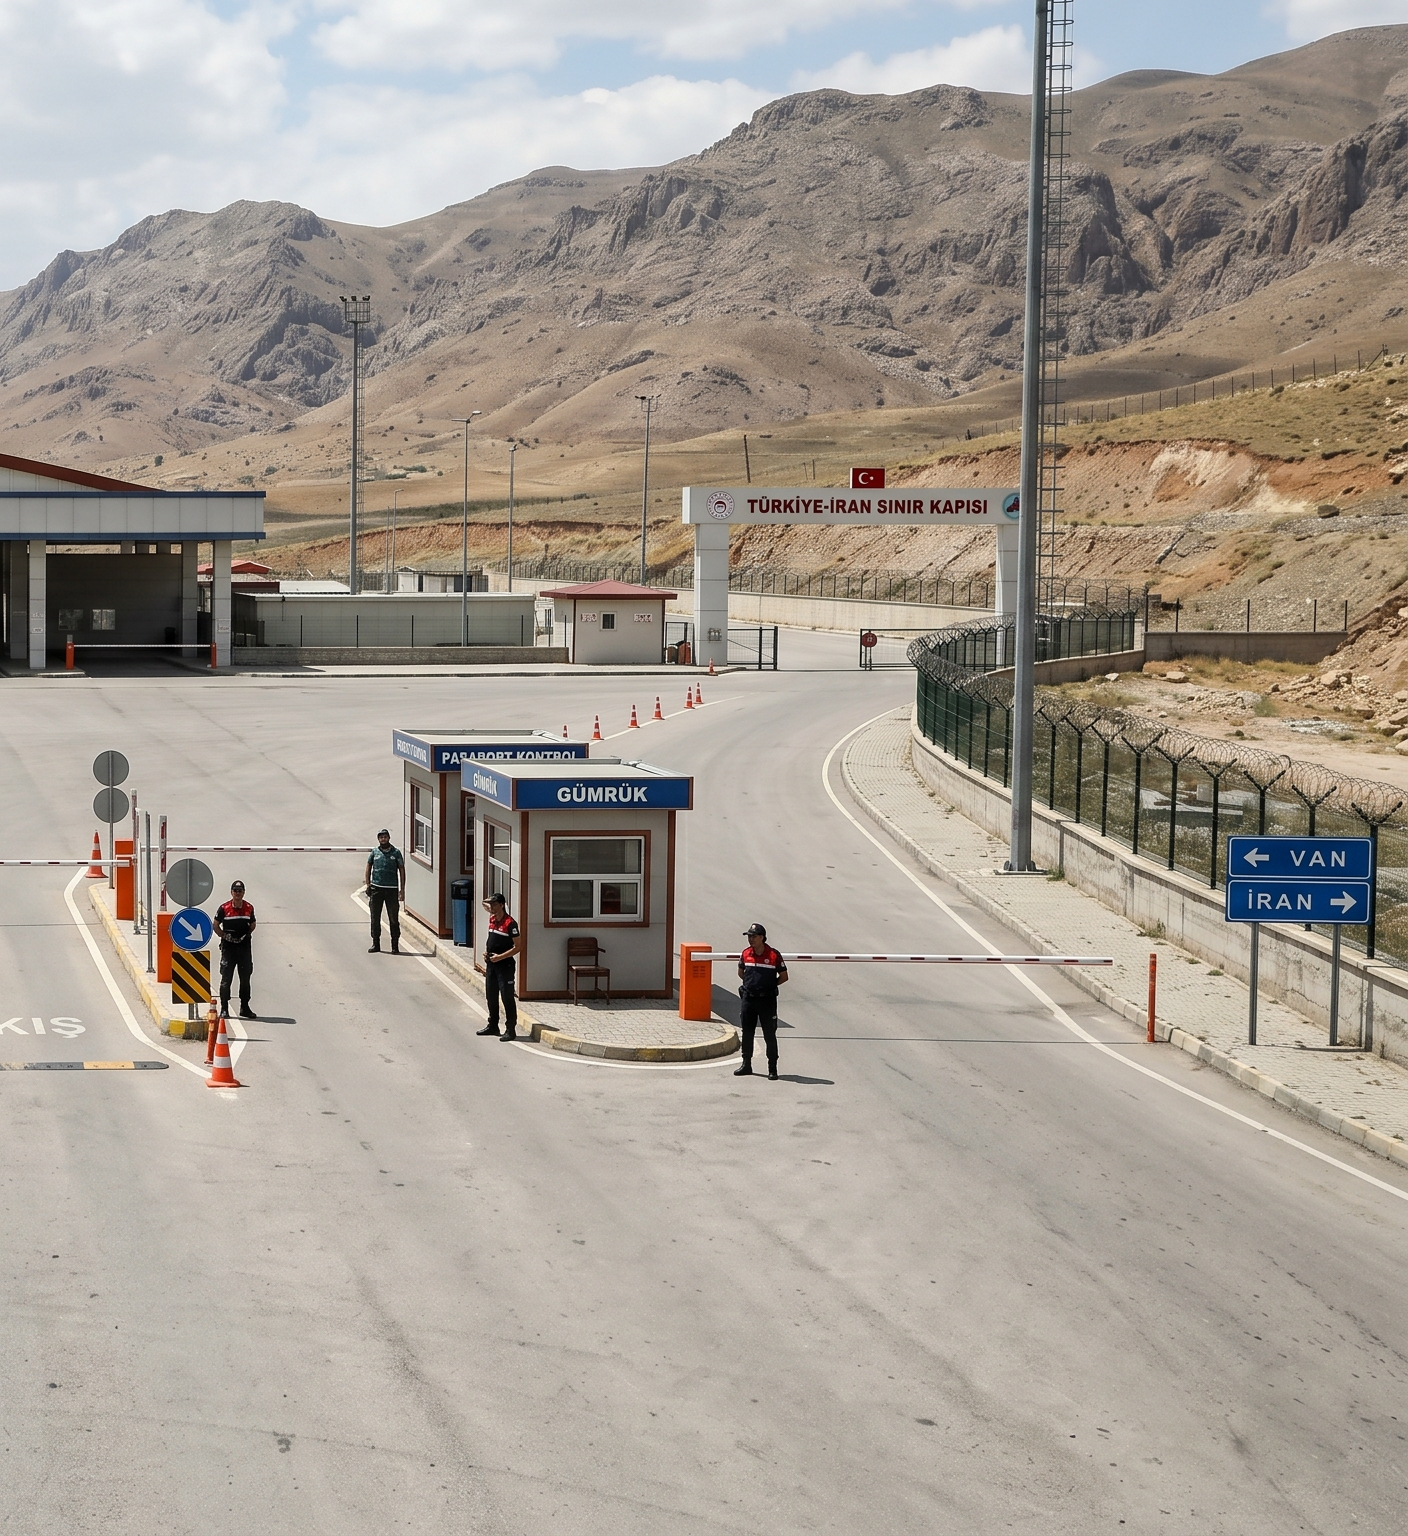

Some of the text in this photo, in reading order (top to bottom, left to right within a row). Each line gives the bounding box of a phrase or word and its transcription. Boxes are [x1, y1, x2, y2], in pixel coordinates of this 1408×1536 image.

[747, 495, 871, 514] TÜRKİYE-İRAN
[877, 499, 924, 514] SINIR
[930, 499, 988, 514] KAPISI
[557, 783, 648, 803] GÜMRÜK
[1290, 850, 1346, 867] VAN
[1248, 889, 1312, 910] İRAN
